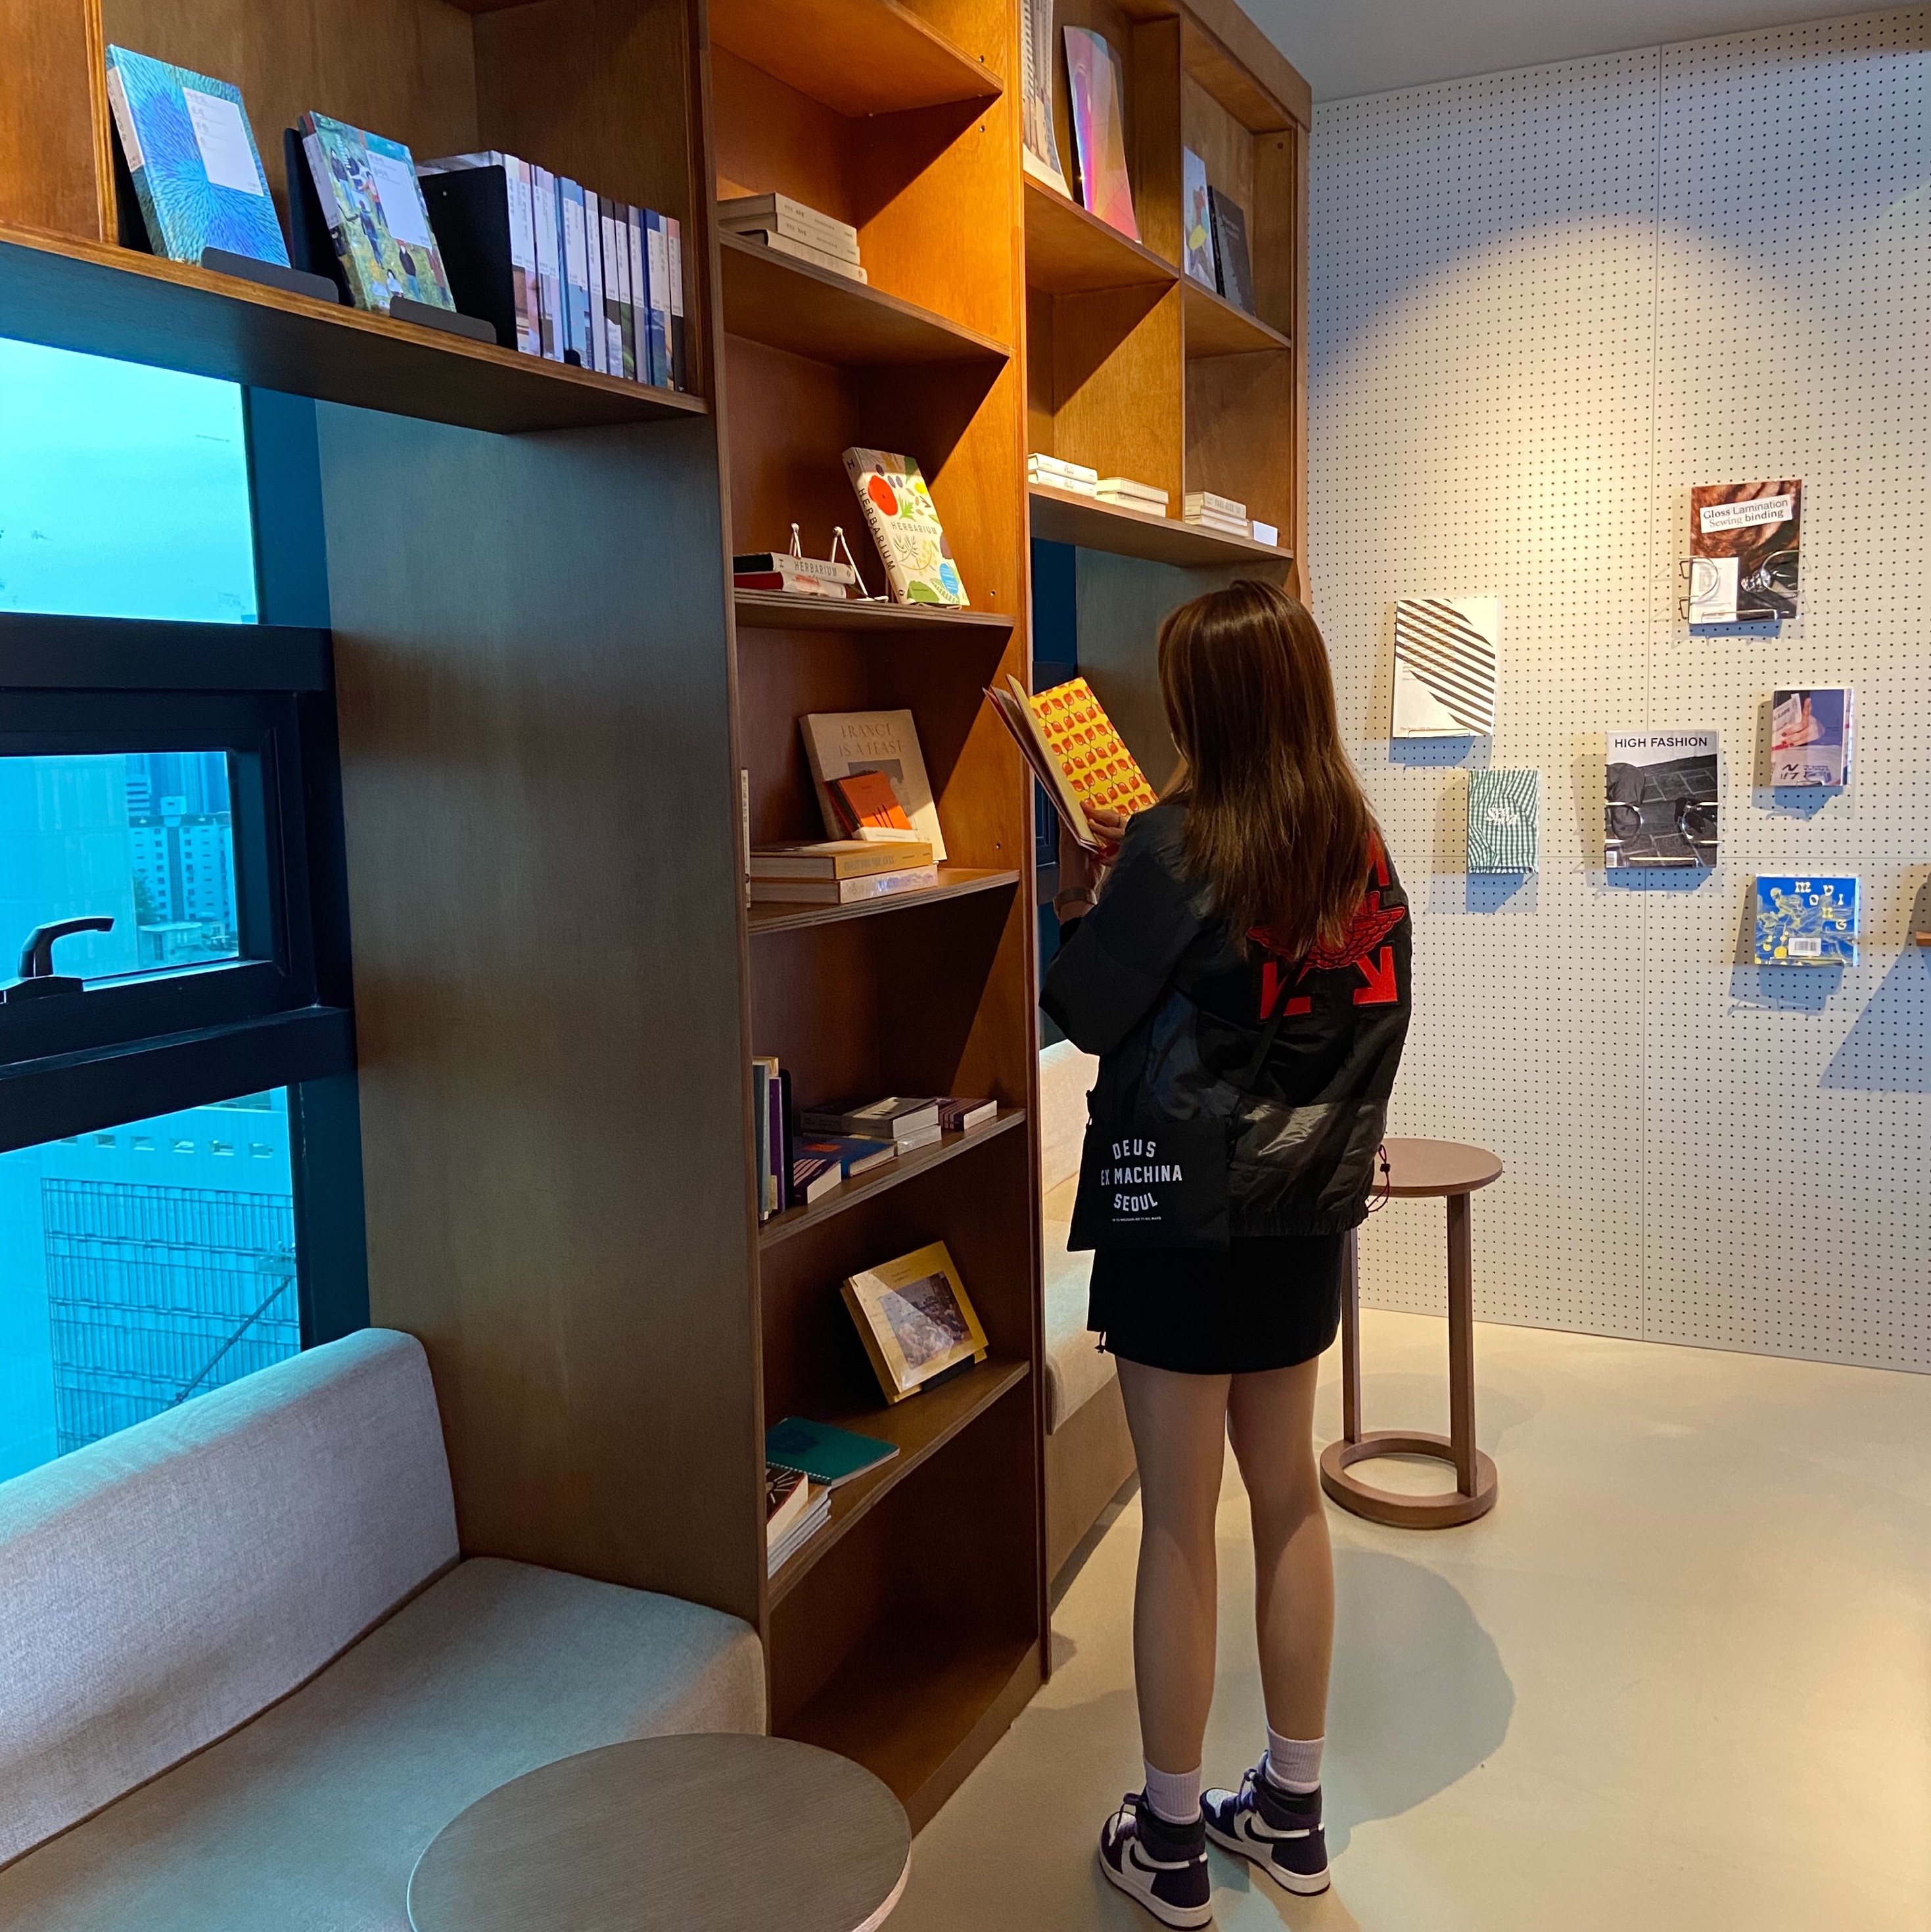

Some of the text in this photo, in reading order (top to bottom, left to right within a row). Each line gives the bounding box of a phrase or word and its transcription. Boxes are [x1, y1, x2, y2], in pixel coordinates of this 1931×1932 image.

[1703, 498, 1788, 519] Gloss Lamination
[891, 521, 938, 535] HERBARIUM
[1709, 509, 1784, 529] Sewing binding
[858, 488, 896, 571] HERBARIUM
[793, 560, 838, 577] HERBARIUM
[1614, 737, 1708, 748] HIGH FASHION
[1112, 1139, 1156, 1160] DEUS
[1101, 1164, 1183, 1186] EX MACHINA
[1113, 1192, 1159, 1212] SEOUL
